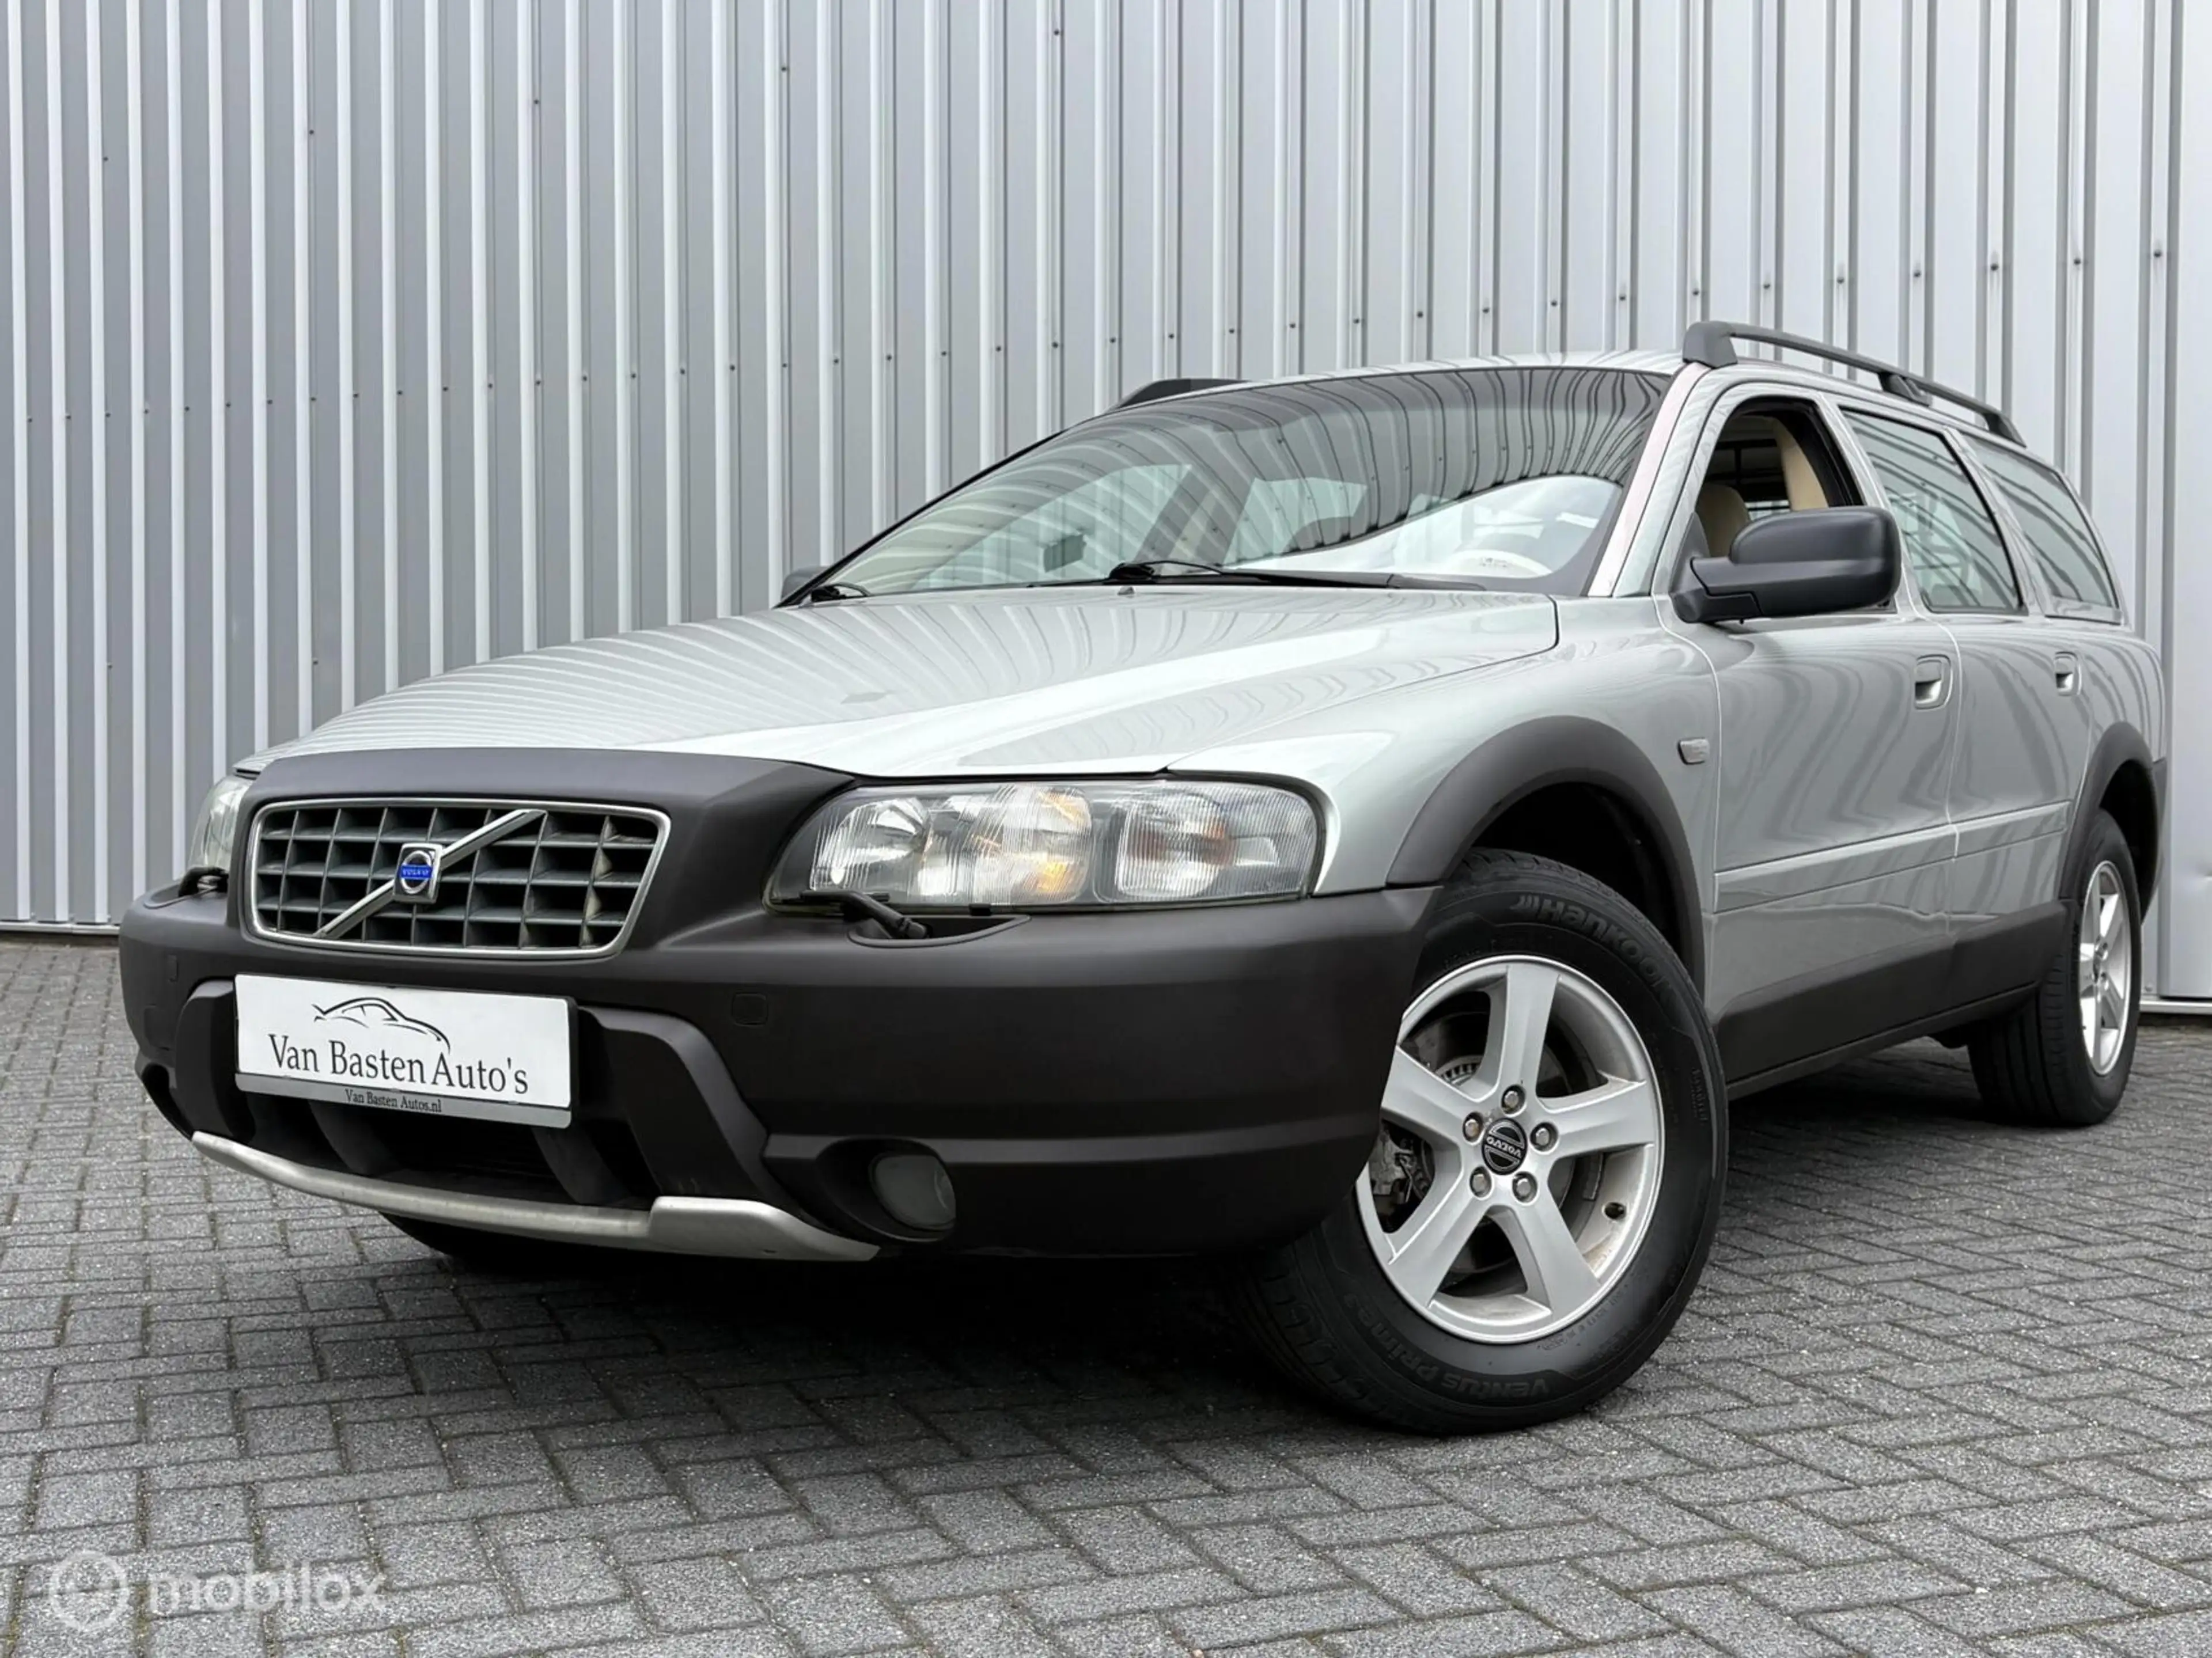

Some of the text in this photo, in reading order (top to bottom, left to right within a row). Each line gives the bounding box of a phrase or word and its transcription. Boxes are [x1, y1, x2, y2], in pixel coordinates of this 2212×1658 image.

[269, 1034, 529, 1094] Van Basten Auto's
[345, 1089, 442, 1113] Van Basten Autos.nl
[1486, 1136, 1521, 1159] VOLVO
